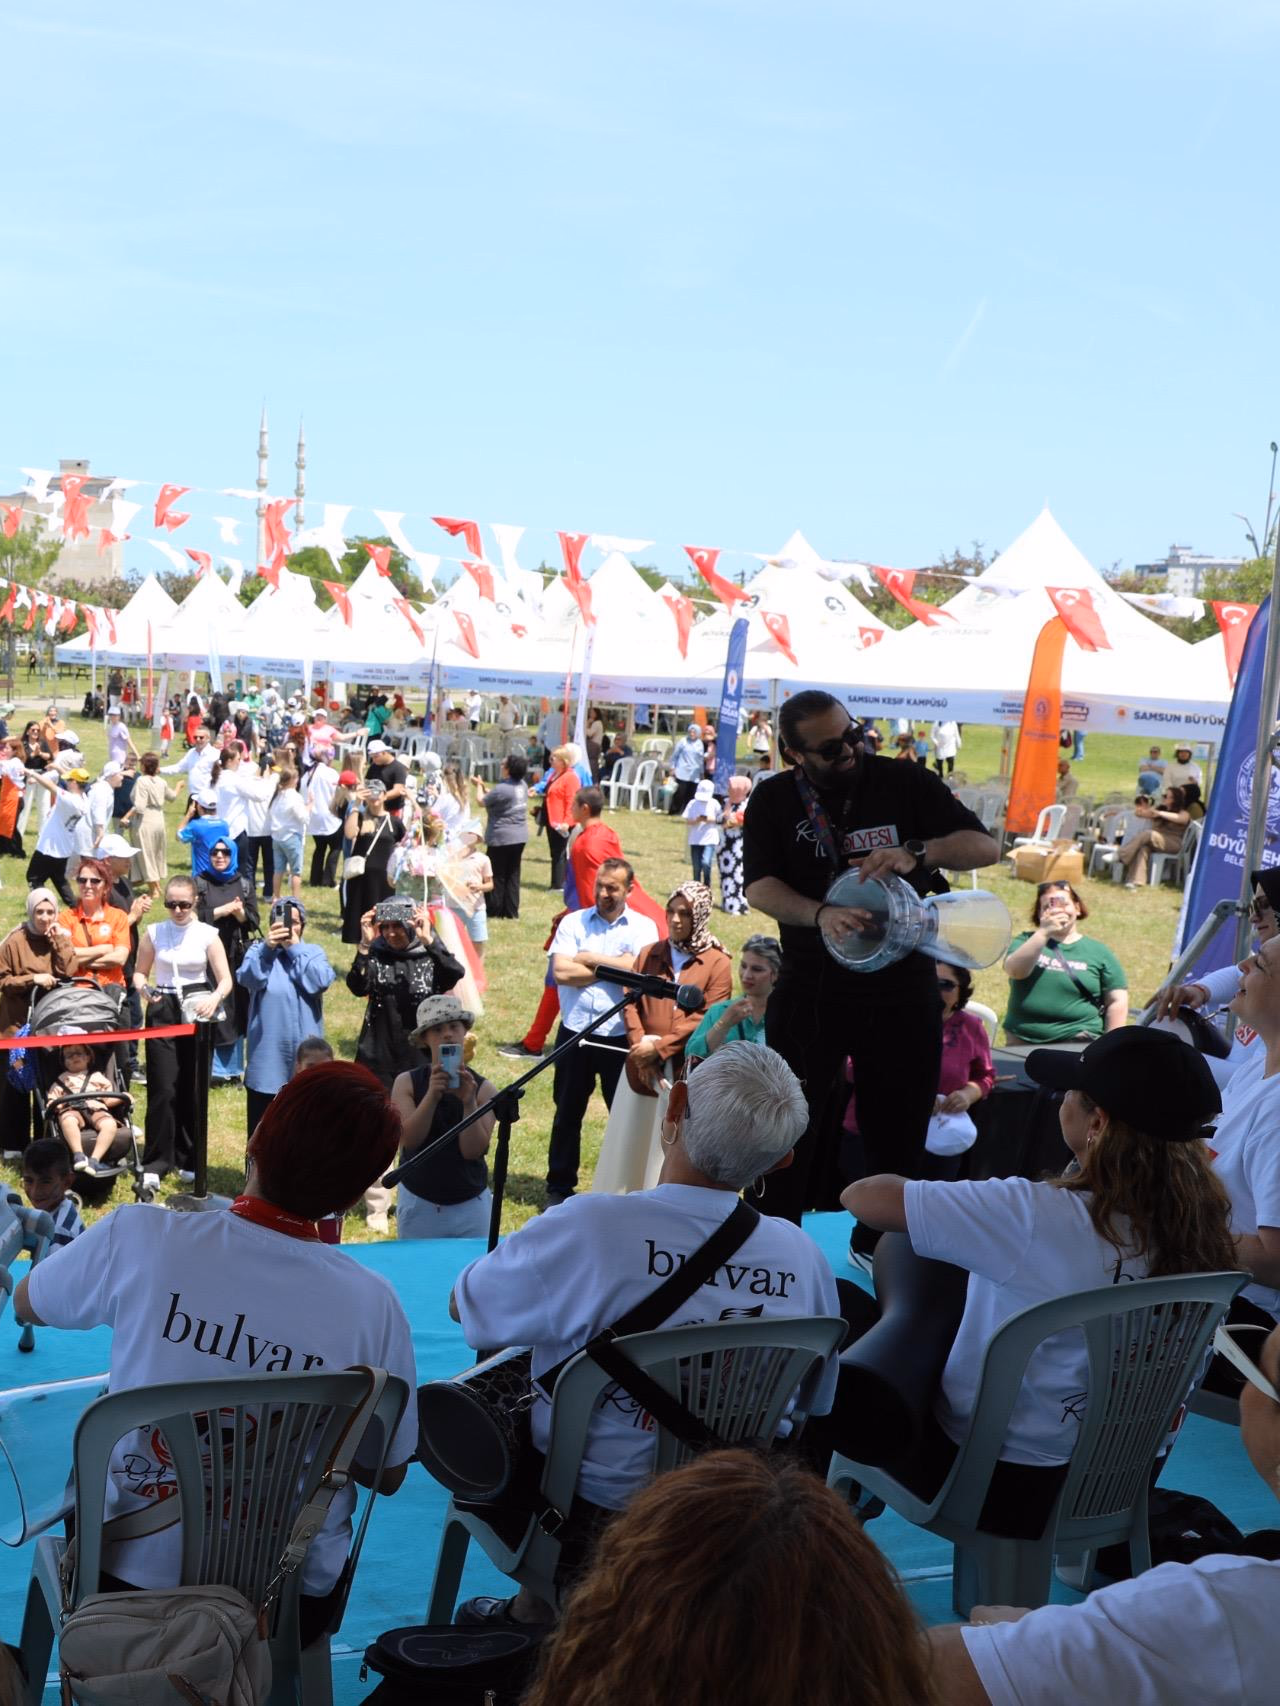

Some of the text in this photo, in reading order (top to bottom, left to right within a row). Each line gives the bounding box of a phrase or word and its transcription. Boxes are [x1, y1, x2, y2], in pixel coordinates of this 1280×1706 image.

[848, 695, 880, 703] SAMSUN
[906, 697, 948, 708] KAMPÜSÜ
[1133, 710, 1182, 723] SAMSUN
